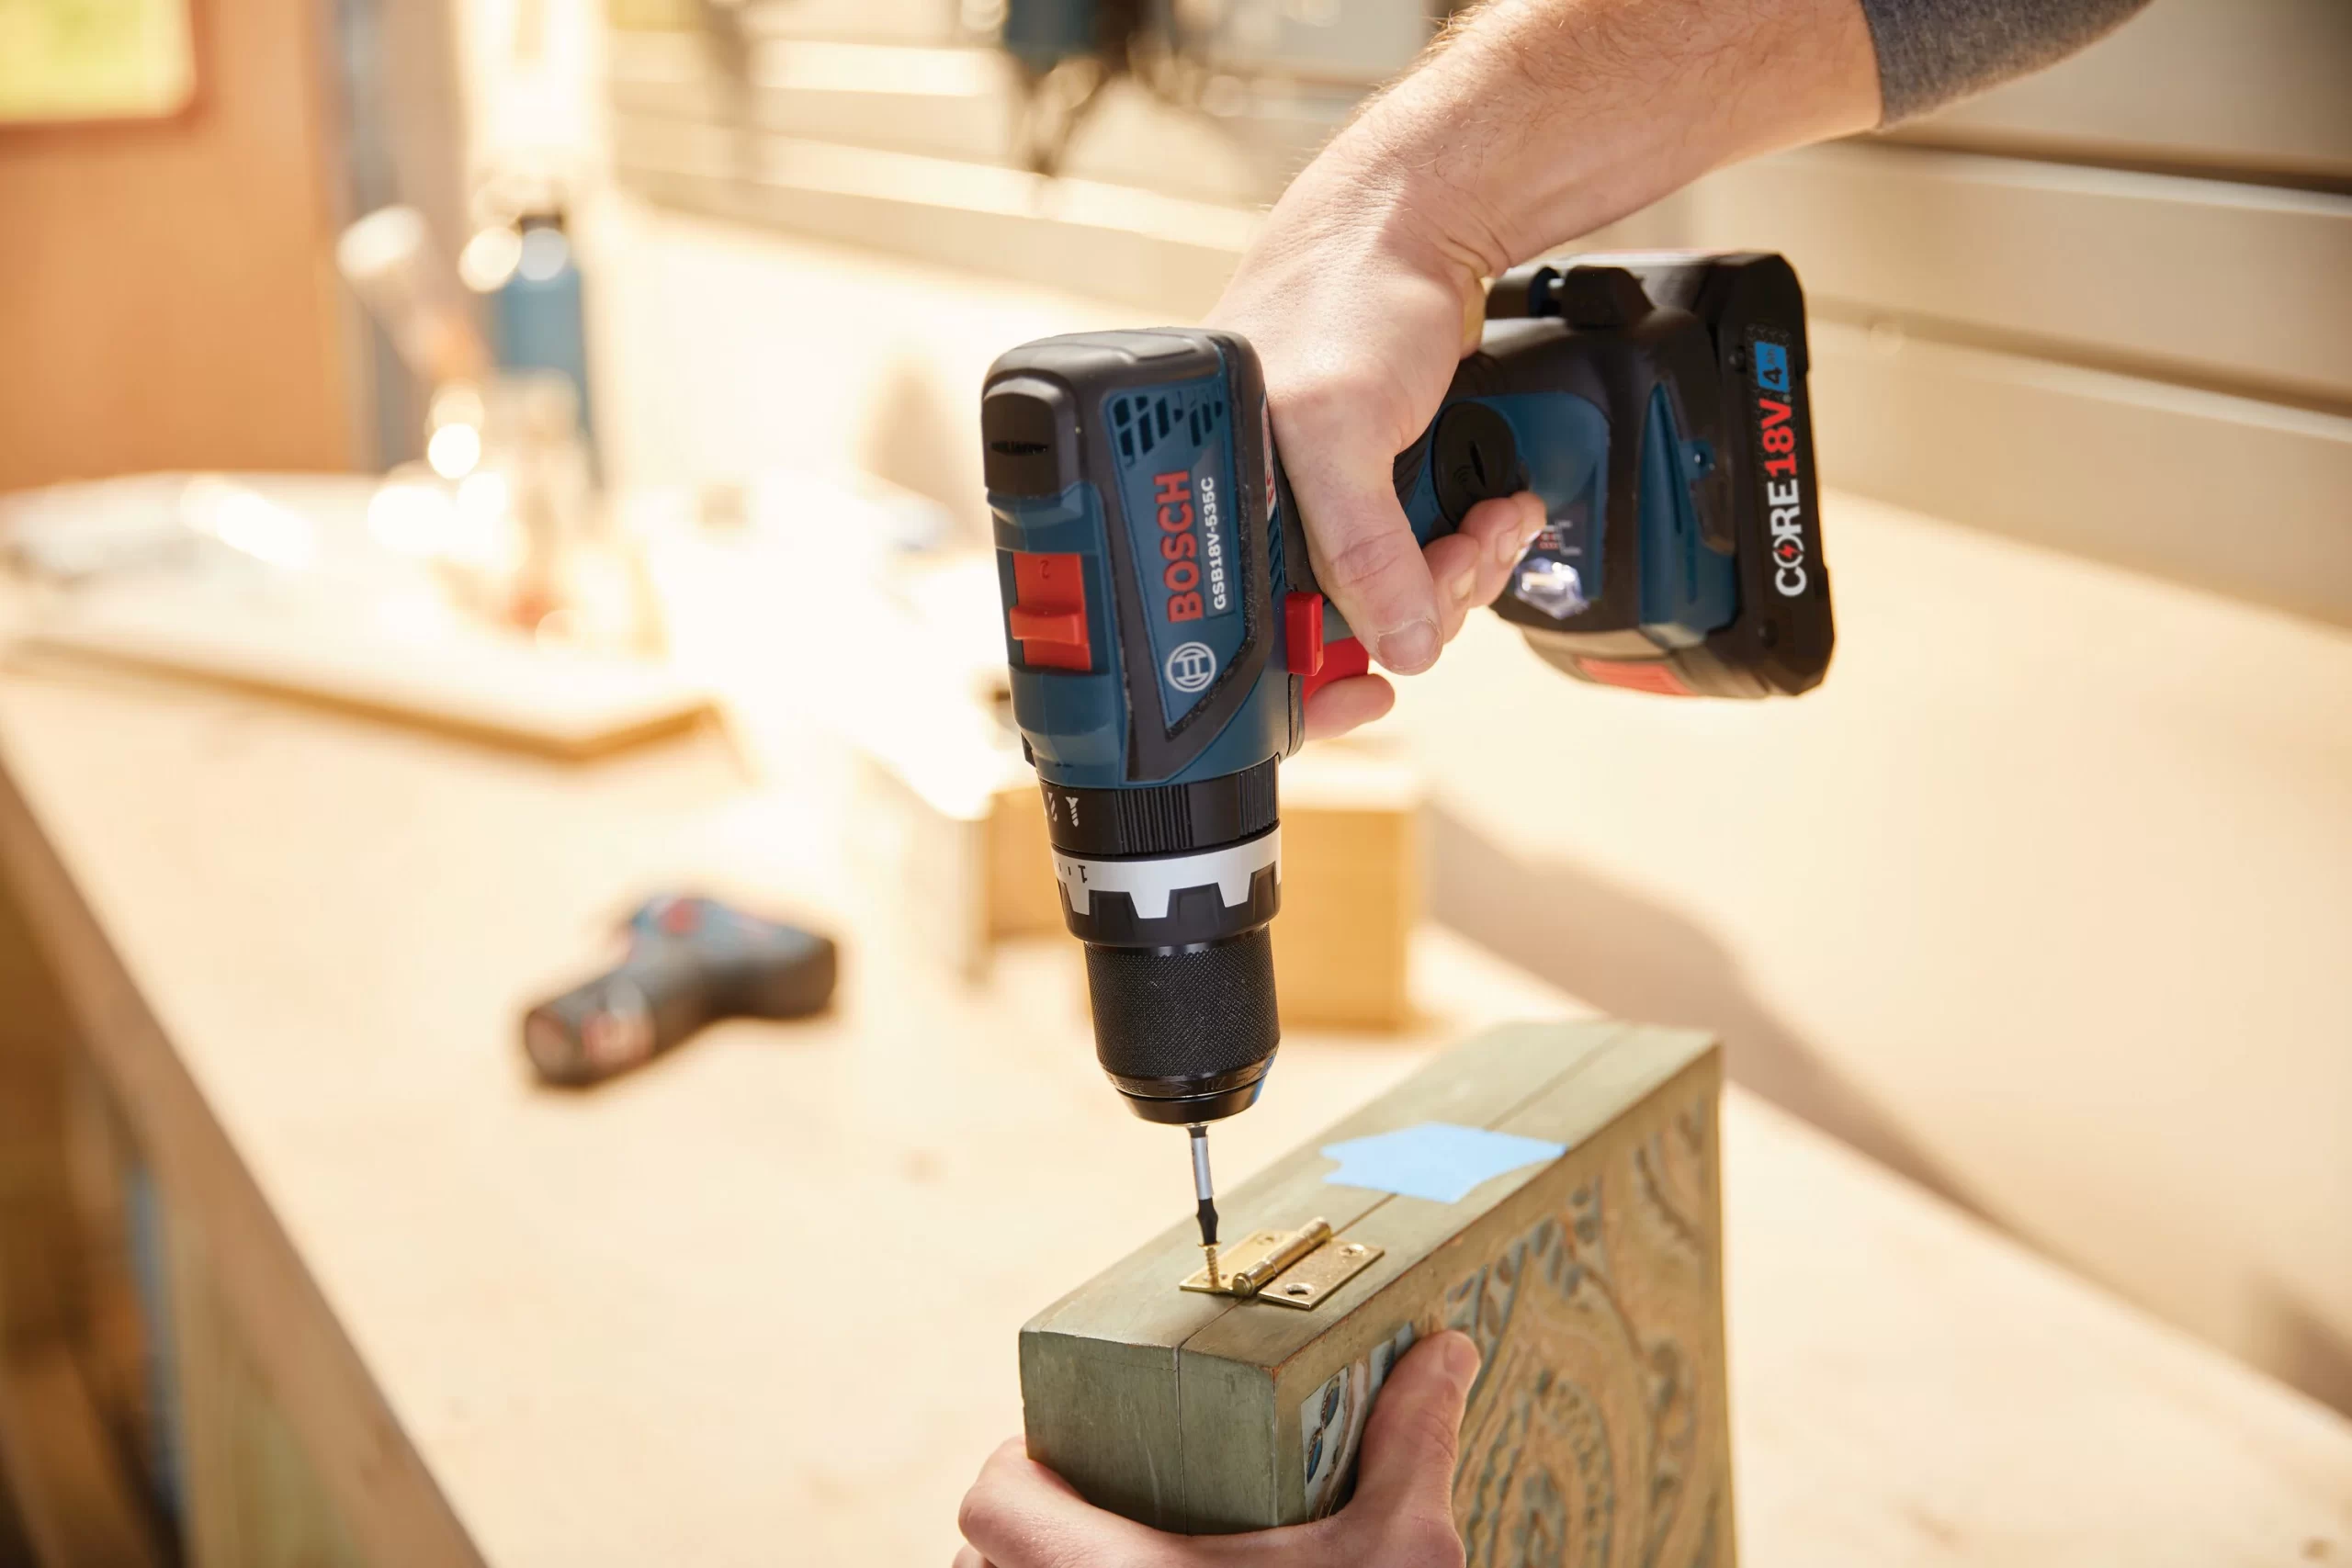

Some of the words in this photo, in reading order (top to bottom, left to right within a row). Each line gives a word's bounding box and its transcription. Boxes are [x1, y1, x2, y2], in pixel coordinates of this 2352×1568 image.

[1154, 470, 1204, 623] BOSCH
[1201, 476, 1226, 610] GSB18V-535C
[1078, 864, 1088, 884] 1
